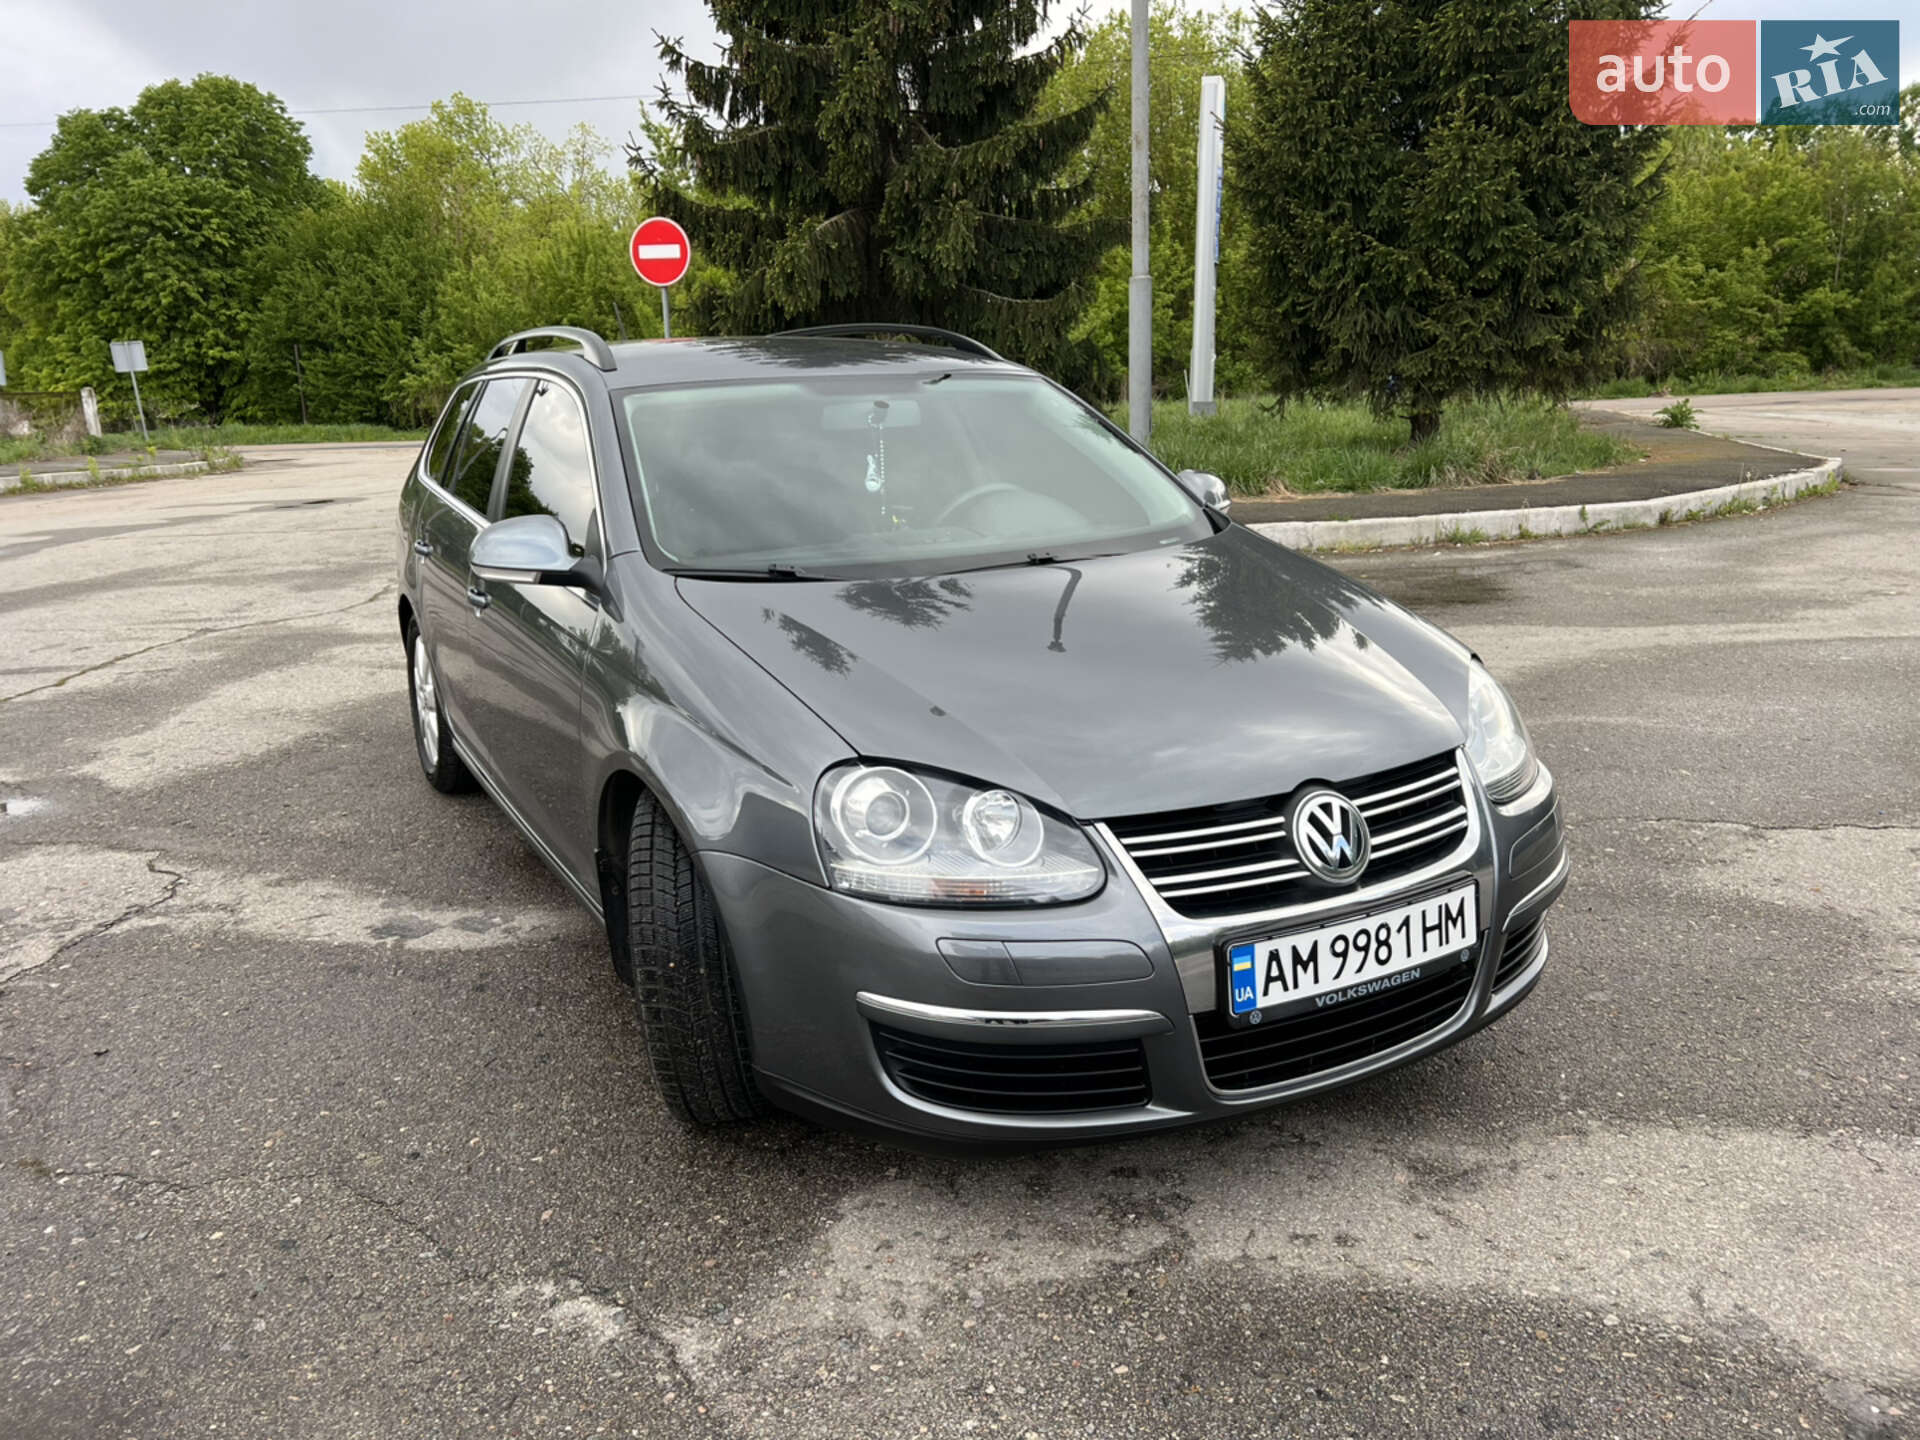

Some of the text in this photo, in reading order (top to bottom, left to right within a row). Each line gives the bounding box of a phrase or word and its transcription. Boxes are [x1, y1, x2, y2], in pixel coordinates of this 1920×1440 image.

[1262, 896, 1466, 997] AM 9981 HM
[1235, 987, 1254, 1002] UA
[1315, 967, 1421, 1008] VOLKSWAGEN
